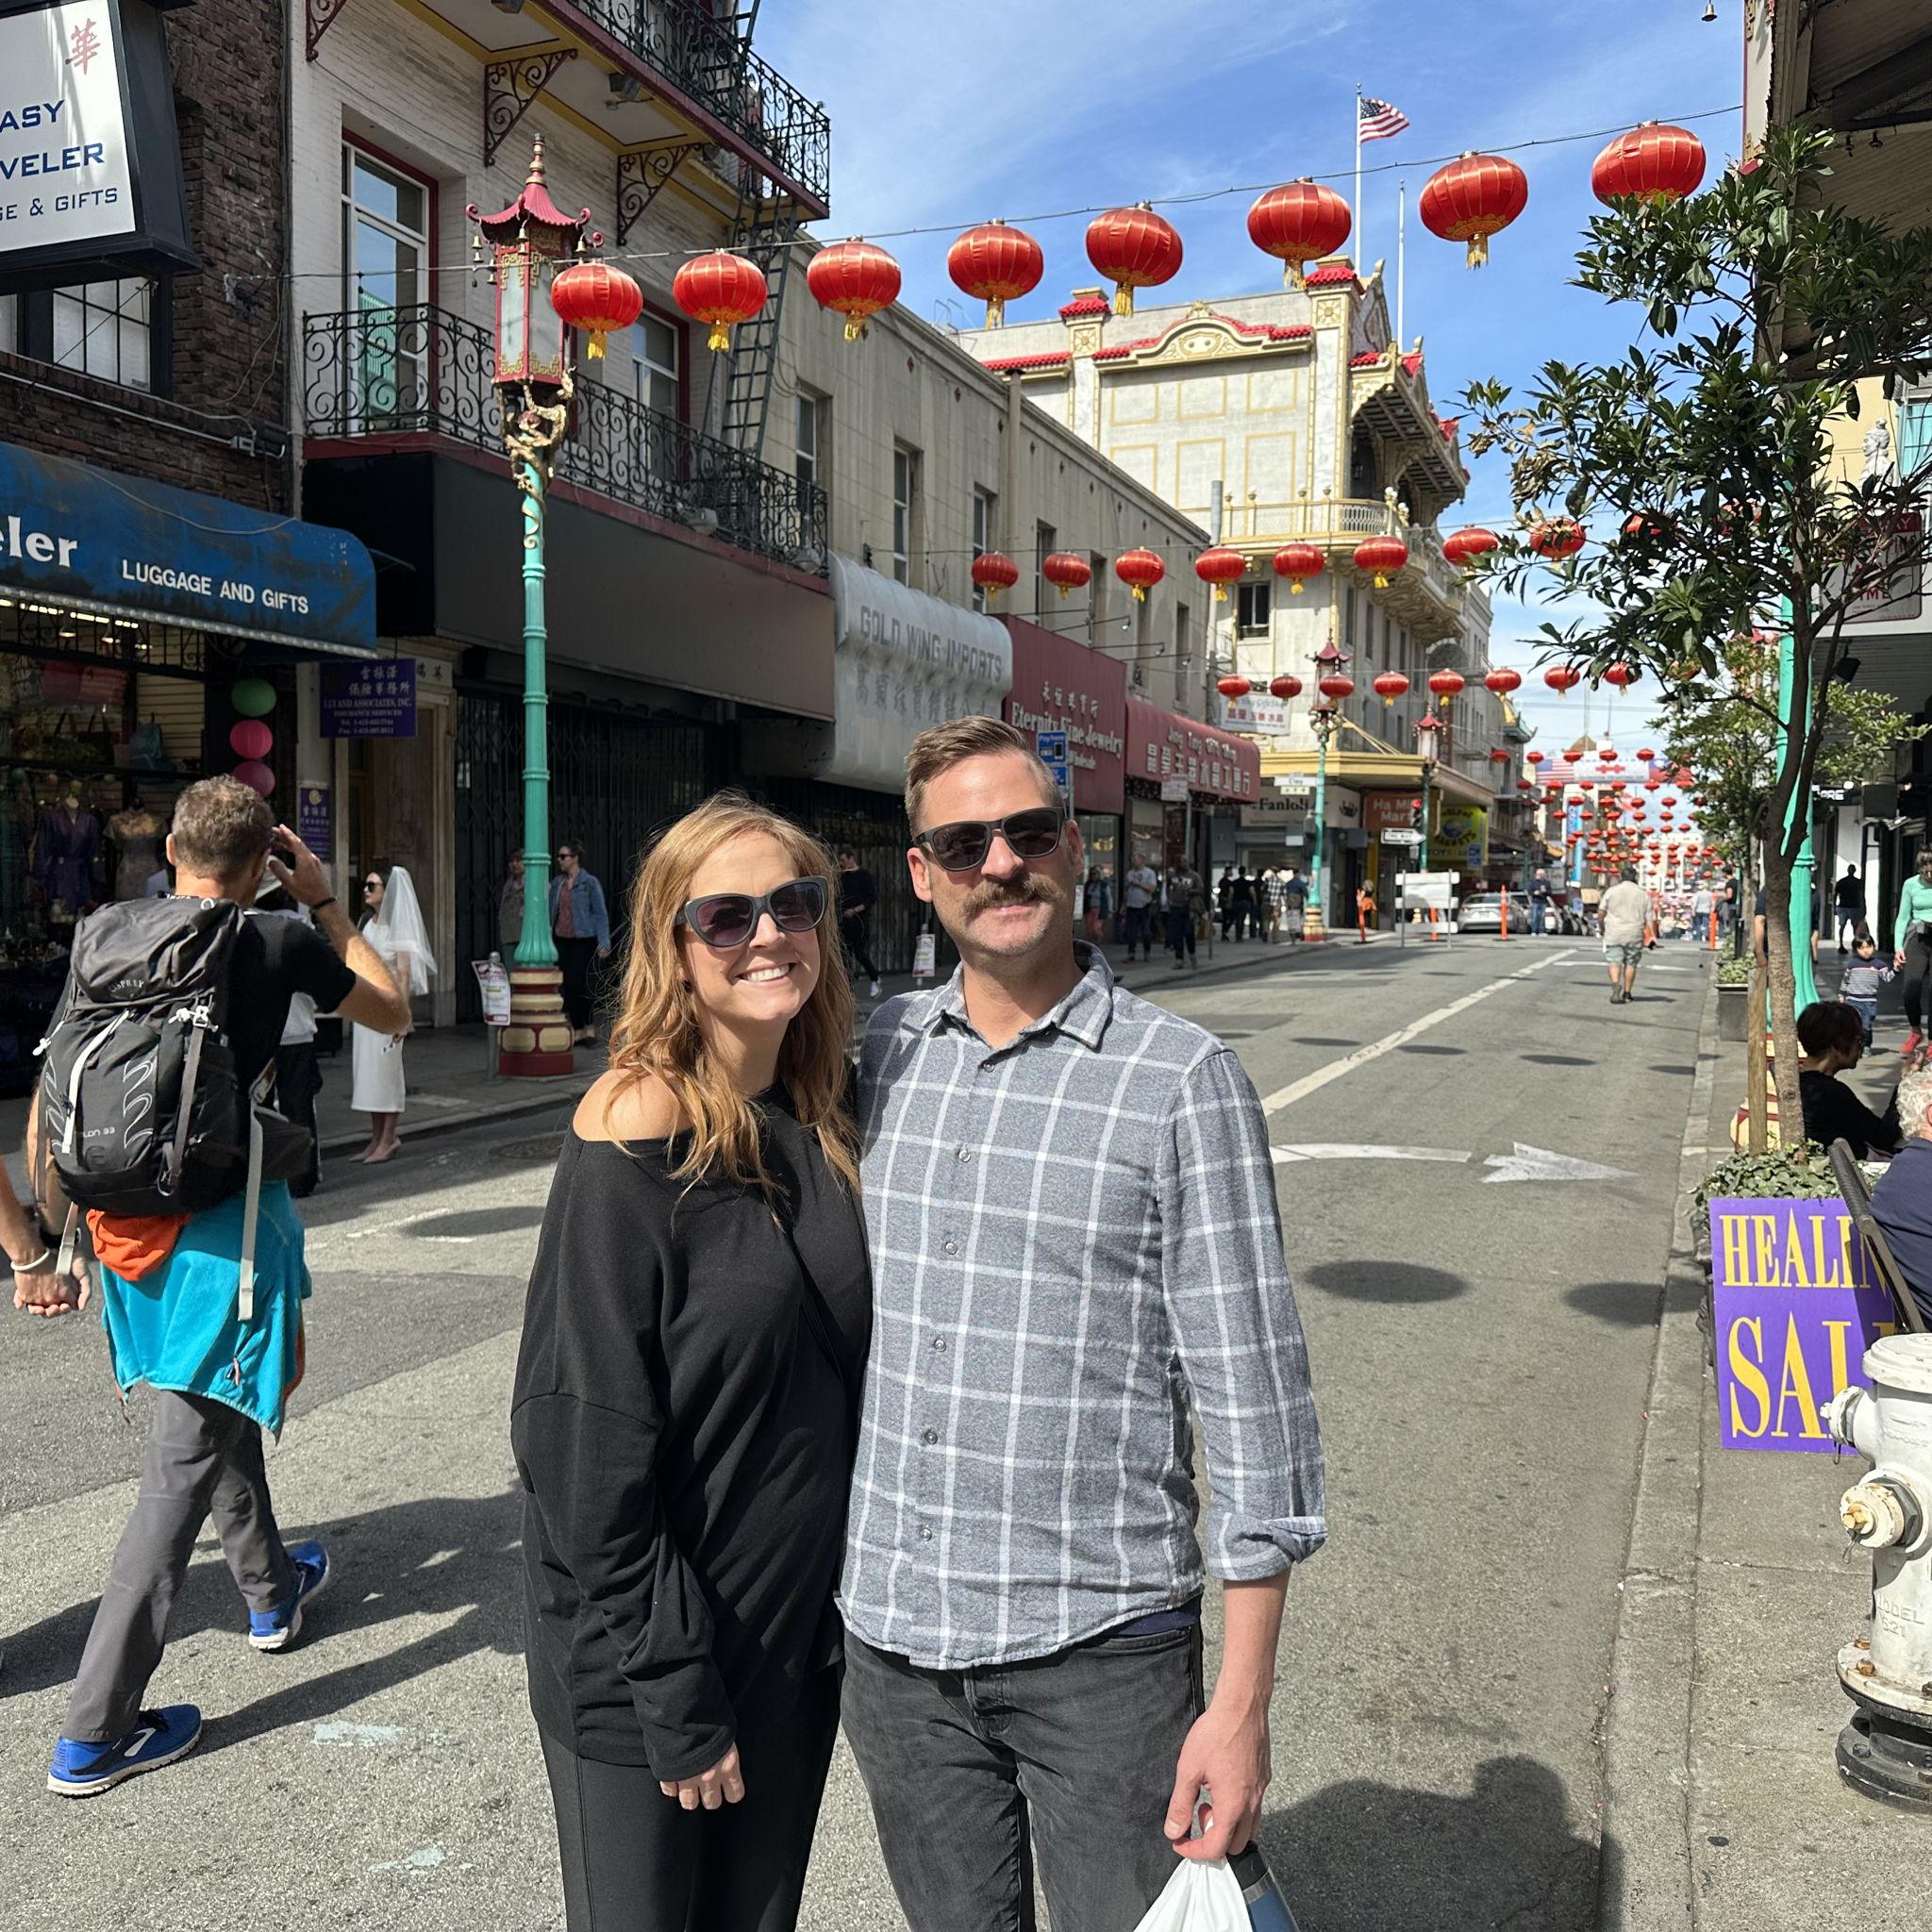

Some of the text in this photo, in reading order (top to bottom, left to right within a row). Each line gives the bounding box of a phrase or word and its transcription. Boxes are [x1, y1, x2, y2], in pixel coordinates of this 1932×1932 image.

[65, 18, 101, 75] 華
[29, 197, 44, 216] &
[55, 187, 118, 212] GIFTS
[0, 515, 78, 568] ler
[122, 558, 309, 615] LUGGAGE AND GIFTS
[860, 605, 1003, 684] GOLD WING IMPORTS
[1011, 702, 1124, 761] Eternity Fine Jewelry
